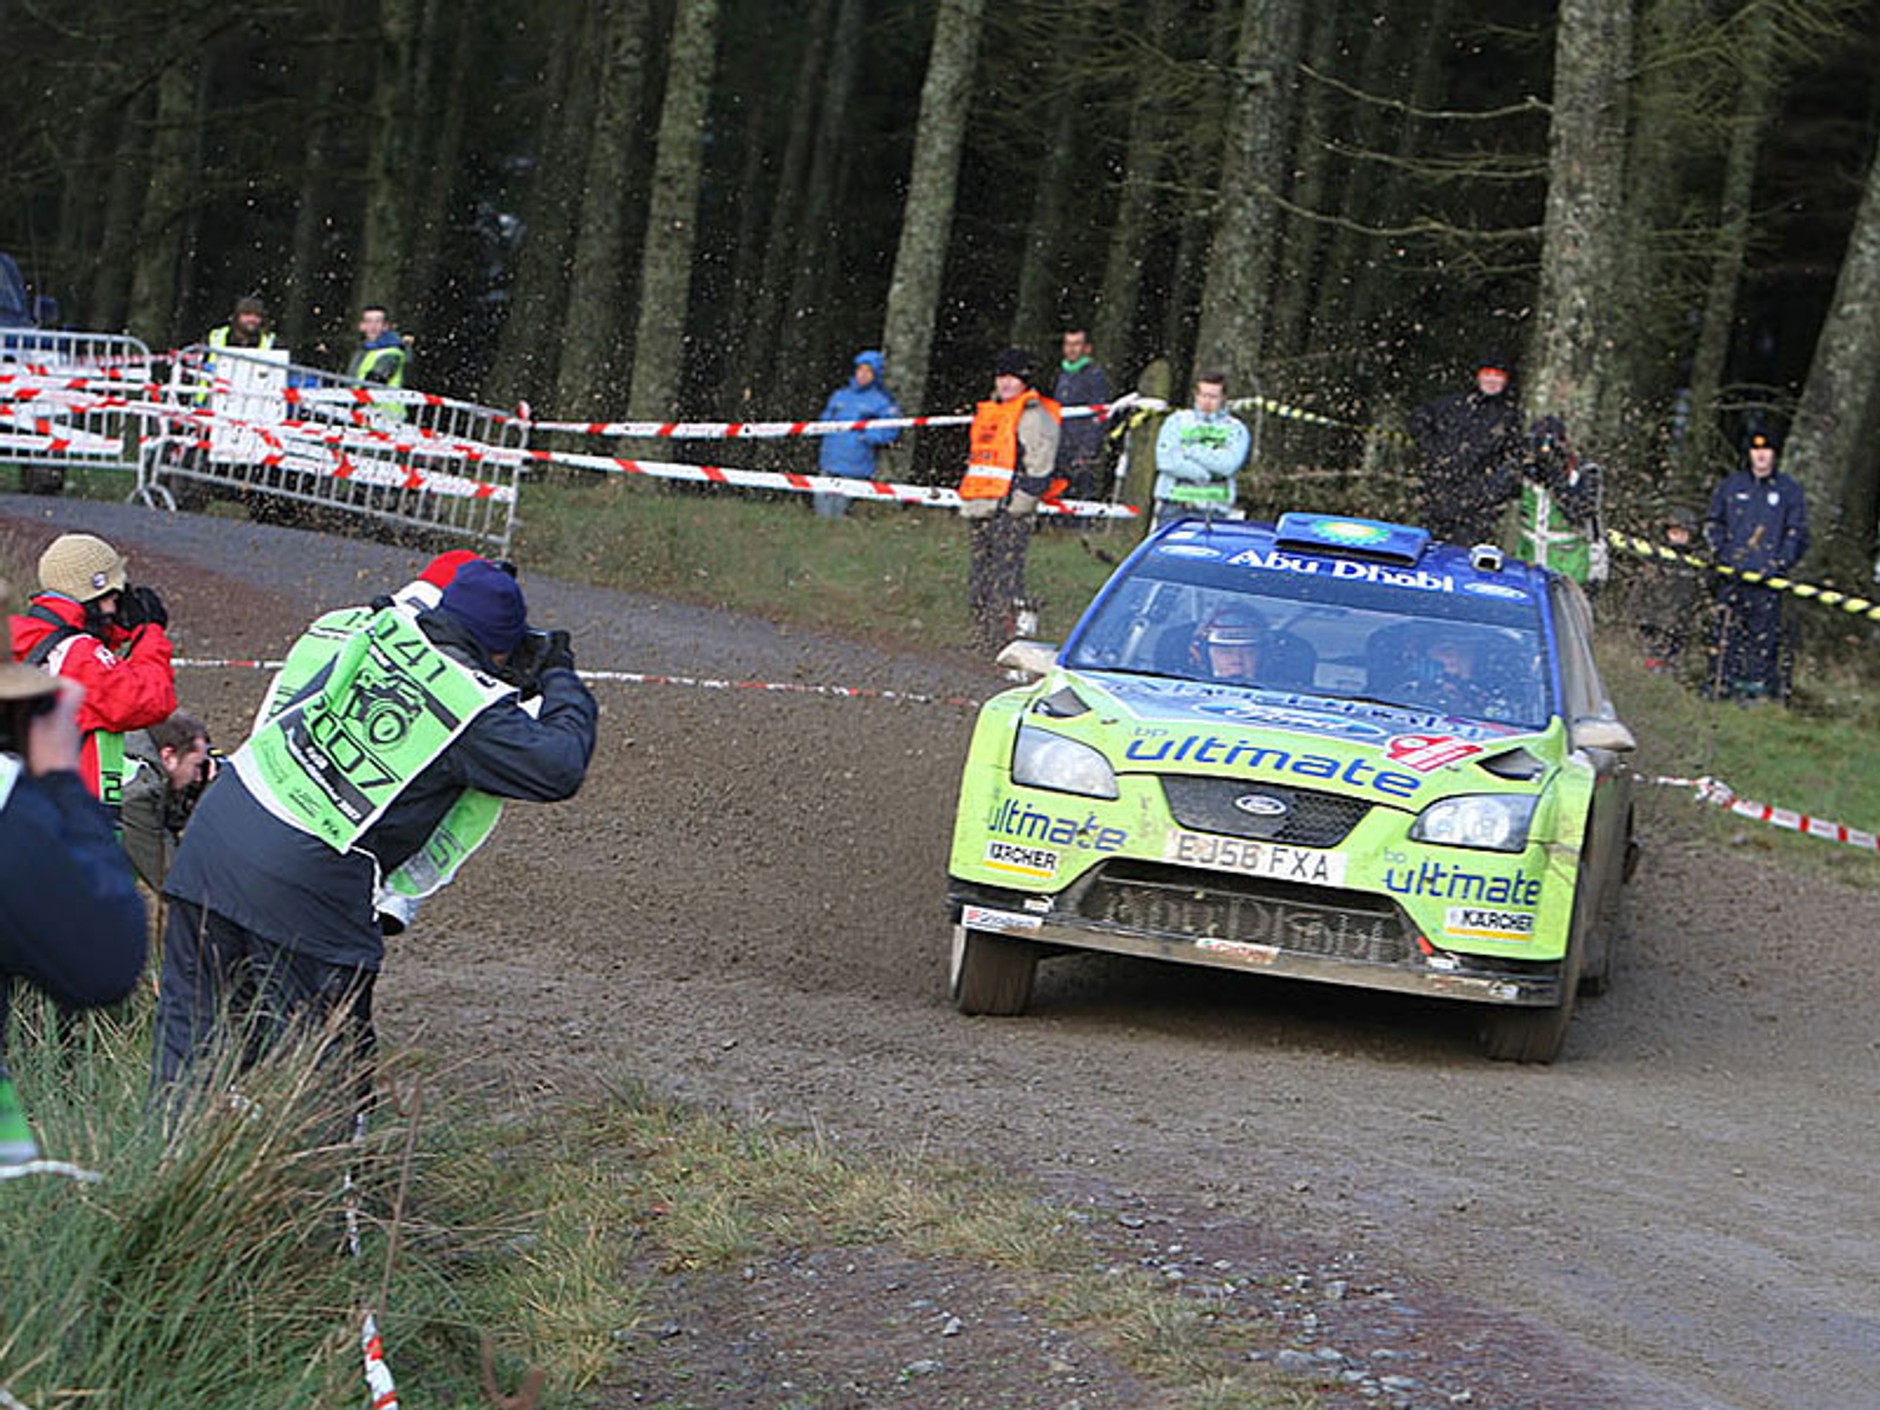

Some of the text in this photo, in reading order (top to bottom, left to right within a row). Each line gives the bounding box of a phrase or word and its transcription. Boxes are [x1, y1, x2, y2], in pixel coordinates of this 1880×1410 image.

[1227, 549, 1318, 574] Abu
[1330, 560, 1454, 593] Dhabi
[1126, 736, 1422, 798] ultimate
[988, 797, 1129, 851] ultimate
[1269, 846, 1329, 881] FXA
[1386, 861, 1542, 906] ultimate
